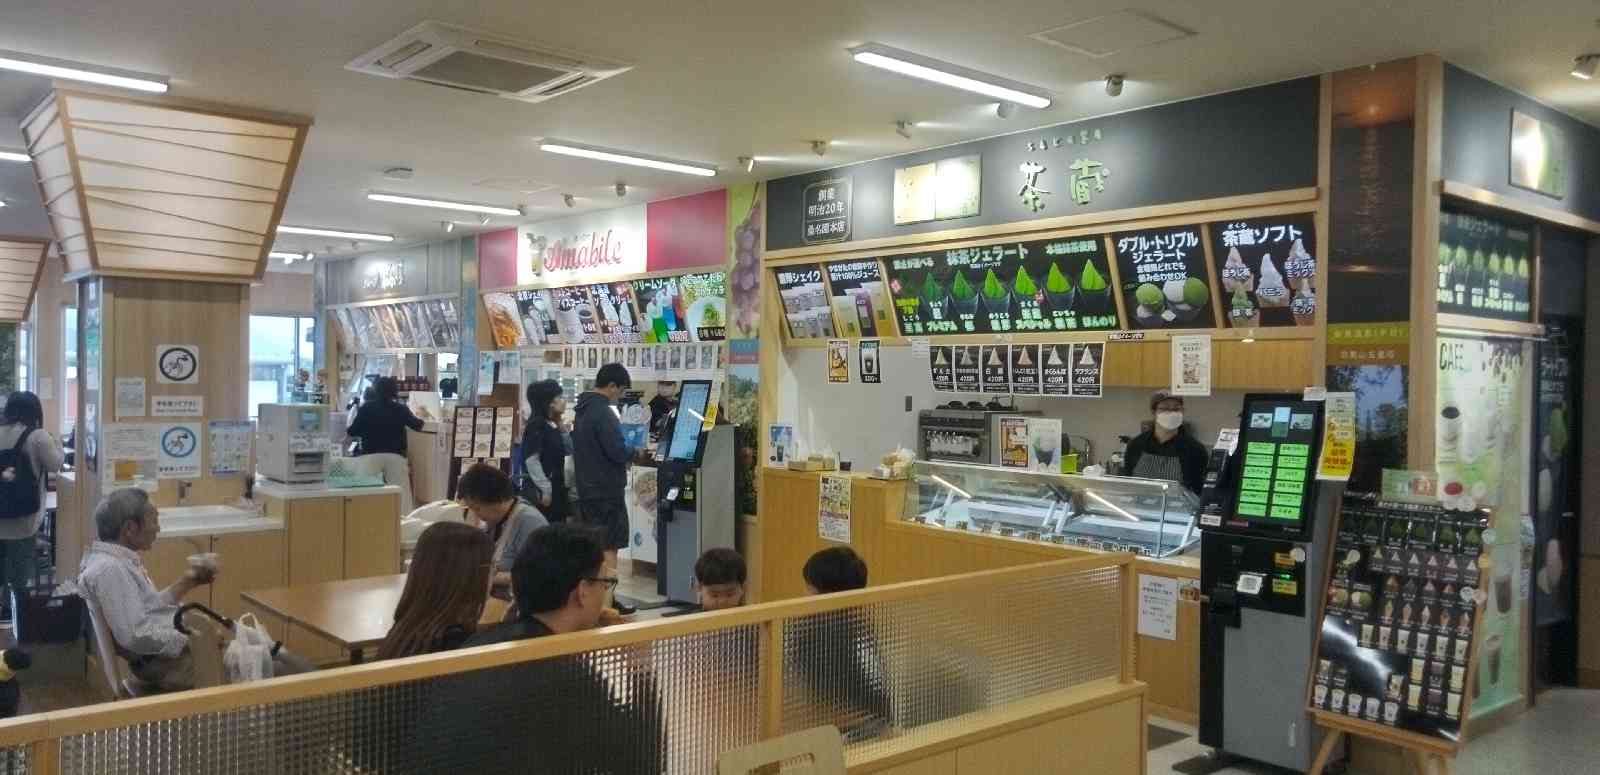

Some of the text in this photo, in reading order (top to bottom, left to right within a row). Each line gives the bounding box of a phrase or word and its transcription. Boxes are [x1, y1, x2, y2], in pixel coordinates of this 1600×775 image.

[808, 201, 846, 217] 明治20年
[1117, 231, 1200, 254] ダブル・トリプル
[1222, 224, 1304, 248] 茶蔵ソフト
[946, 243, 1029, 266] 抹茶ジェラート
[1132, 249, 1187, 264] ジェラート
[1439, 342, 1465, 371] CAFE
